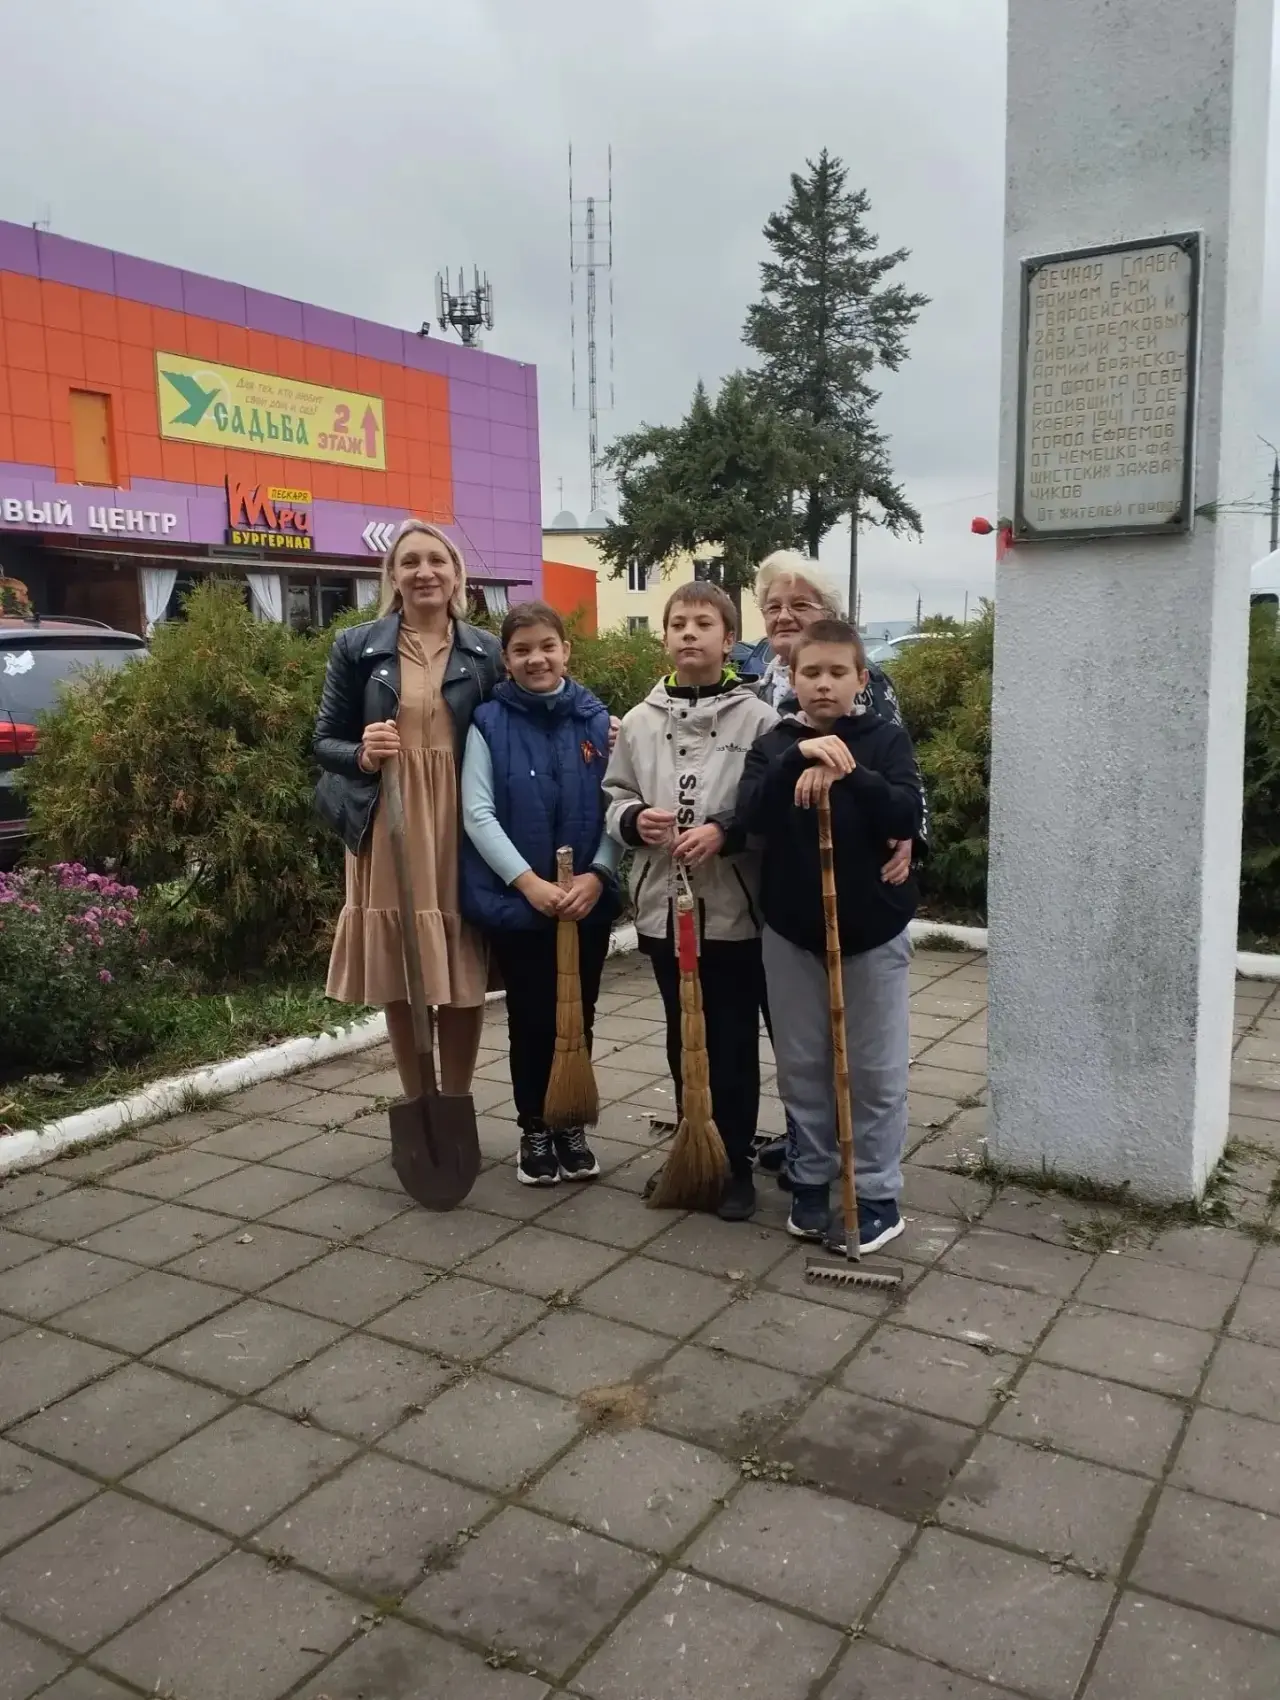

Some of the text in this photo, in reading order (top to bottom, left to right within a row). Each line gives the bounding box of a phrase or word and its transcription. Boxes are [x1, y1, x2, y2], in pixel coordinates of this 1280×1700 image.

[1039, 251, 1179, 289] ВЕЧНАЯ СЛАВА
[1035, 286, 1101, 309] ВОИНАМ
[1035, 294, 1157, 327] ГВАРДЕЙСКОЙ
[1074, 312, 1190, 341] СТРЕЛКОВЫХ
[1033, 360, 1090, 380] АРМИИ
[1033, 383, 1053, 398] ГО
[1061, 374, 1128, 396] ФРОНТА
[1132, 388, 1147, 405] 13
[333, 404, 350, 434] 2
[1032, 405, 1176, 433] КАБРЯ 1941 ГОДА
[318, 432, 363, 455] ЭТАЖ
[1031, 423, 1175, 450] ГОРОД ЕФРЕМОВ
[1031, 451, 1051, 467] ОТ
[1030, 463, 1111, 485] ШИСТСКИХ
[271, 488, 309, 501] ПЕСКАРЯ
[1030, 484, 1082, 500] ЧИКОВ
[0, 497, 177, 533] ВЫЙ ЦЕНТР
[1059, 500, 1122, 520] ЖИТЕЛЕЙ
[232, 530, 311, 549] БУРГЕРНАЯ
